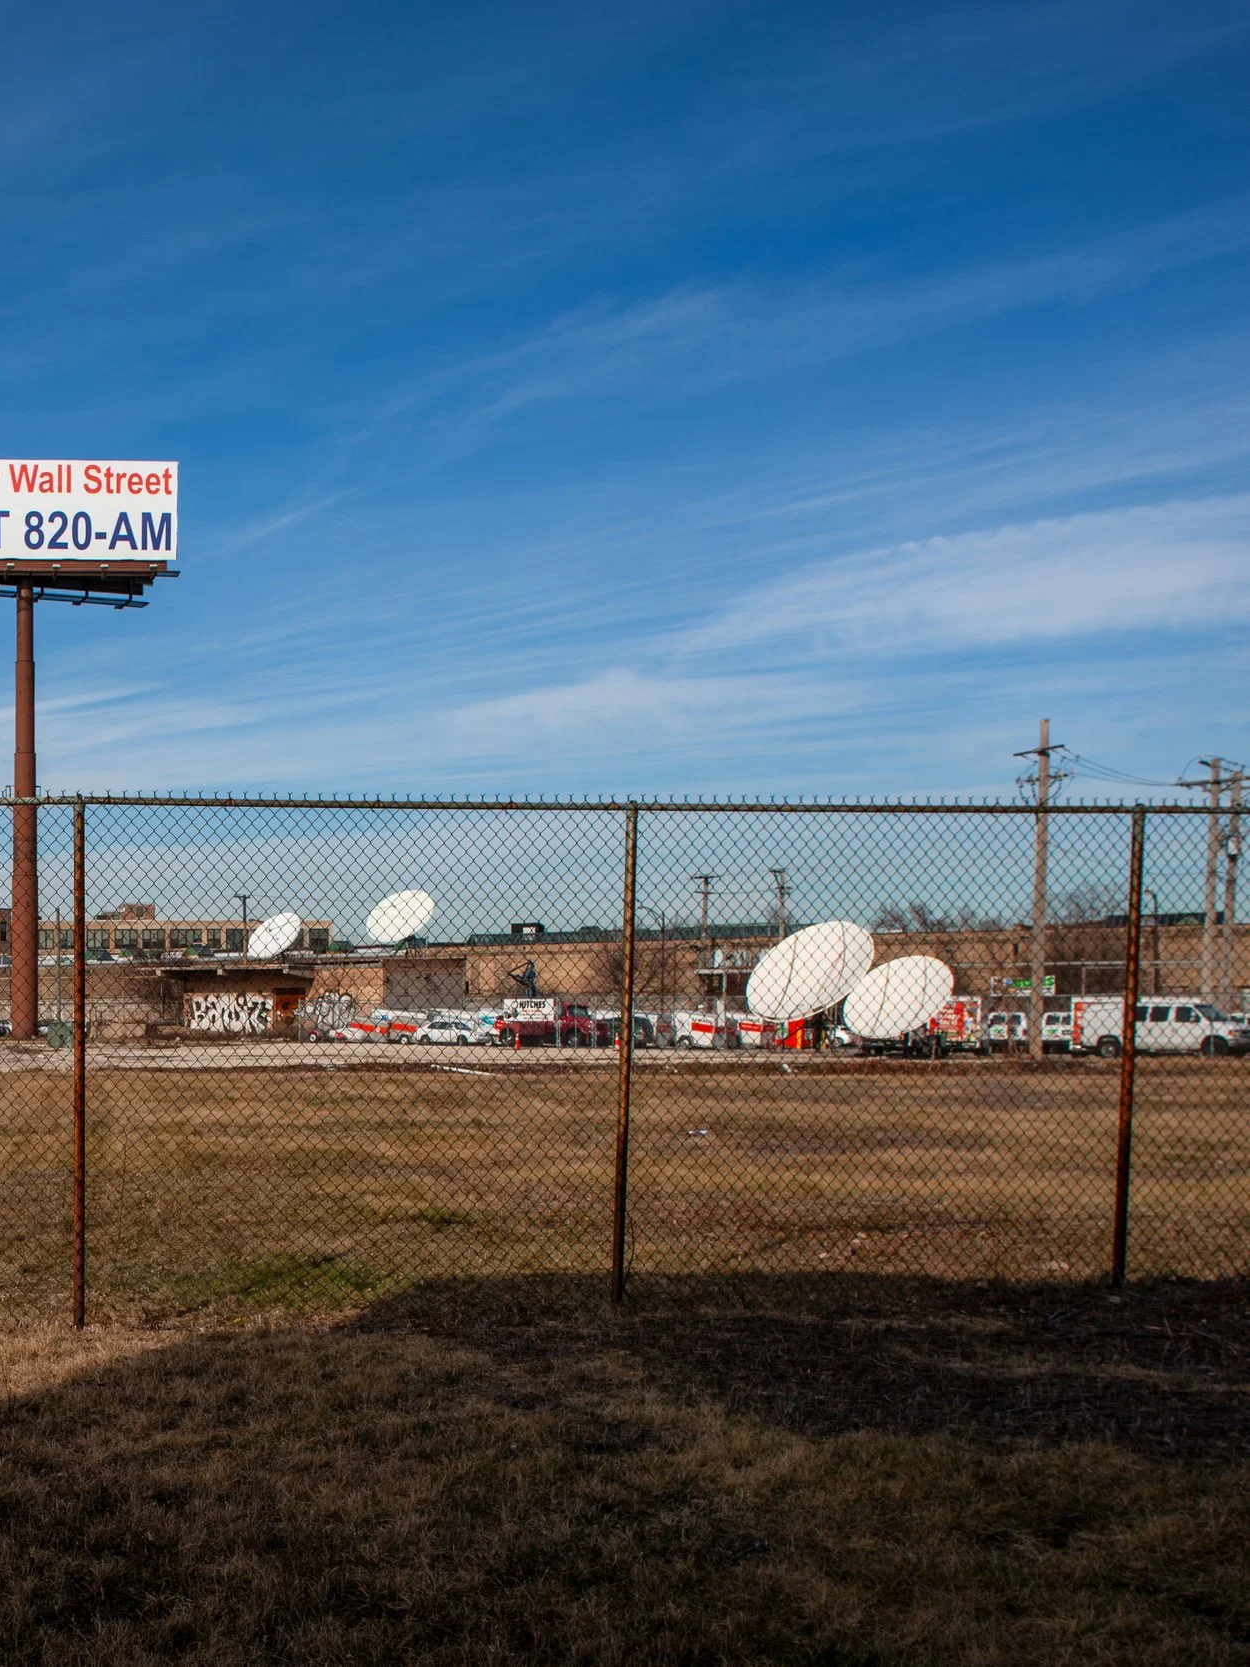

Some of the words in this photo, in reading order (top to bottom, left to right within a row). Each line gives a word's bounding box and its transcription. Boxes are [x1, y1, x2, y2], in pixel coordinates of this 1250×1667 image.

[9, 463, 72, 493] Wall
[83, 464, 173, 495] Street
[24, 510, 172, 551] 820-AM
